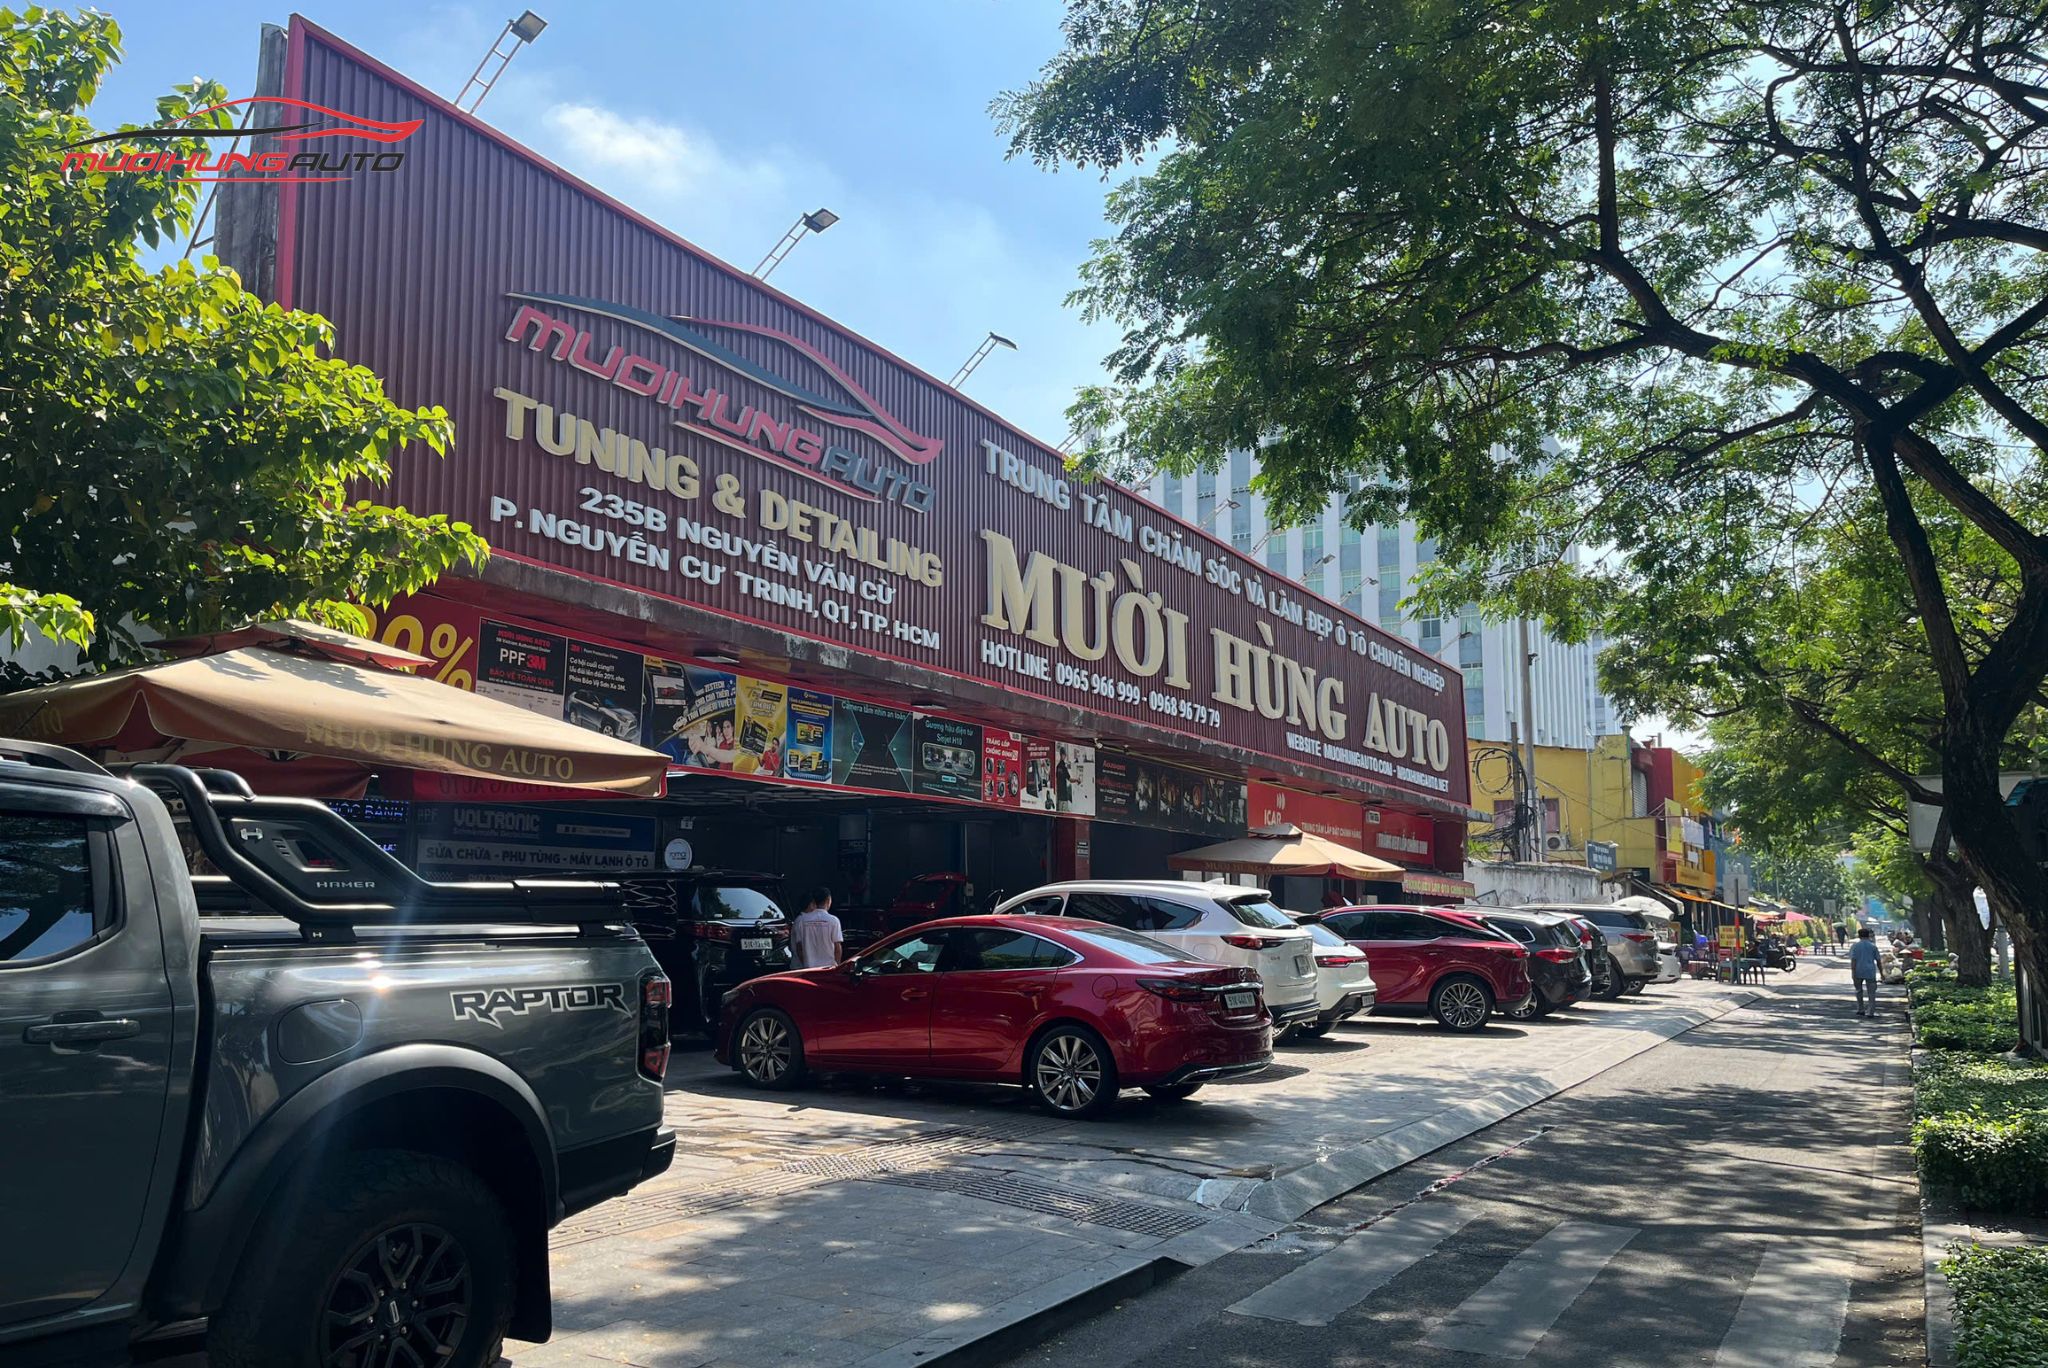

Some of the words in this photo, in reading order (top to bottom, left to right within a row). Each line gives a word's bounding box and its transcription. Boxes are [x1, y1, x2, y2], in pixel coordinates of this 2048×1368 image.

[494, 387, 700, 499] TUNING
[712, 473, 747, 519] &
[760, 489, 943, 588] DETAILING
[529, 508, 670, 572] NGUYỄN
[679, 556, 727, 586] CƯ
[579, 487, 668, 532] 235B
[677, 516, 798, 576] NGUYỄN
[803, 559, 855, 594] VĂN
[860, 577, 896, 605] CỪ
[980, 438, 1071, 510] TRUNG
[1079, 494, 1133, 543] TÂM
[1139, 525, 1202, 577] CHĂM
[1205, 556, 1241, 595] SÓC
[1244, 572, 1267, 609] VÀ
[1268, 589, 1303, 626] LÀM
[1304, 610, 1333, 641] ĐẸP
[1335, 620, 1346, 646] Ô
[1349, 631, 1367, 656] TÔ
[1368, 641, 1411, 678] CHUYÊN
[1411, 664, 1445, 696] NGHIỆP
[500, 648, 526, 665] PPF
[527, 654, 547, 671] 3M
[980, 528, 1191, 690] MƯỜI
[1210, 621, 1347, 741] HÙNG
[1363, 692, 1449, 773] AUTO
[1055, 662, 1089, 692] 0965
[1091, 673, 1115, 699] 966
[1117, 681, 1140, 706] 999
[1149, 690, 1178, 717] 0968
[500, 752, 575, 780] AUTO
[453, 808, 540, 832] VOLTRONIC
[1264, 809, 1282, 825] ICAR
[502, 851, 528, 865] PHỤ
[529, 850, 560, 864] TÙNG
[569, 852, 593, 866] MÁY
[595, 855, 623, 869] LẠNH
[625, 855, 633, 867] Ô
[635, 856, 649, 868] TÔ
[450, 983, 633, 1030] RAPTOR
